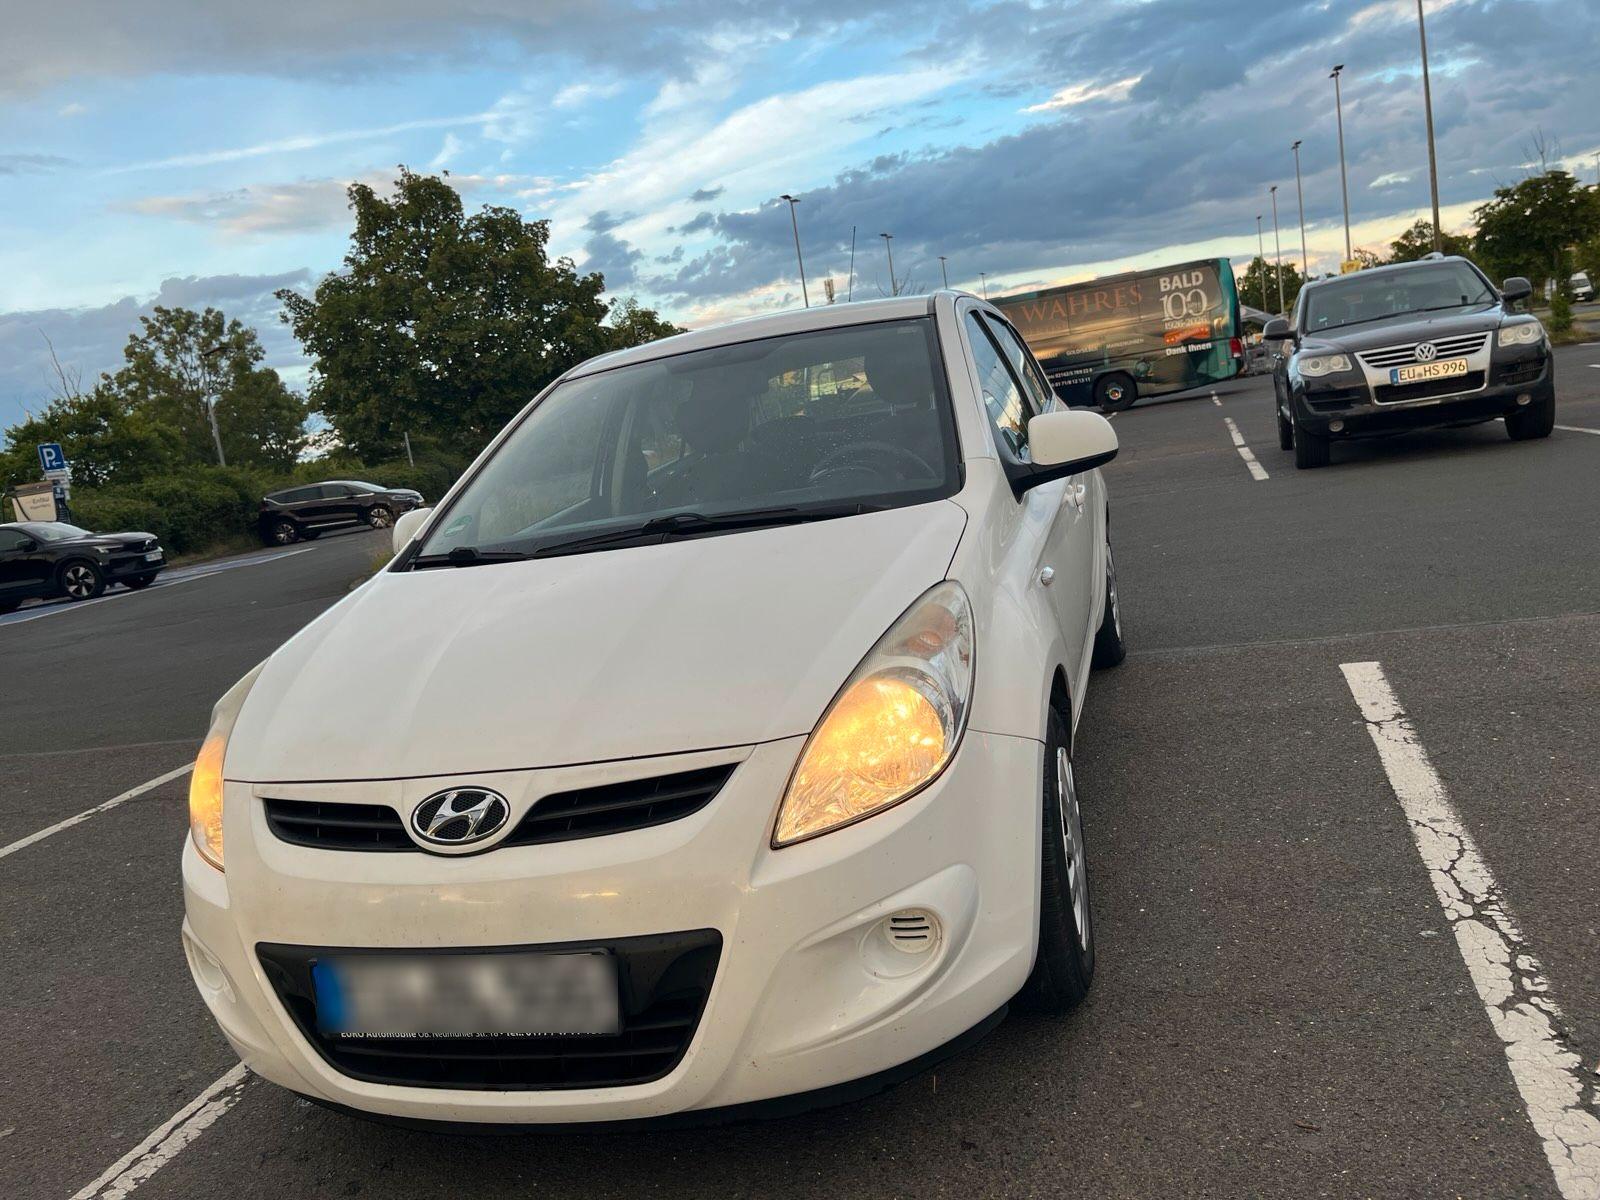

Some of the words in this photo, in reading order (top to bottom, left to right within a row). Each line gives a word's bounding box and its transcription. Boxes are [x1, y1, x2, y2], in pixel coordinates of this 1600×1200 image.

[1159, 271, 1203, 292] BALD
[1021, 284, 1143, 322] WAHRES
[1160, 288, 1208, 321] 100
[1166, 345, 1187, 356] Dank
[1188, 342, 1212, 352] Ihnen
[1399, 368, 1416, 381] EU
[1423, 364, 1440, 377] HS
[1442, 361, 1466, 374] 996
[42, 447, 56, 468] P
